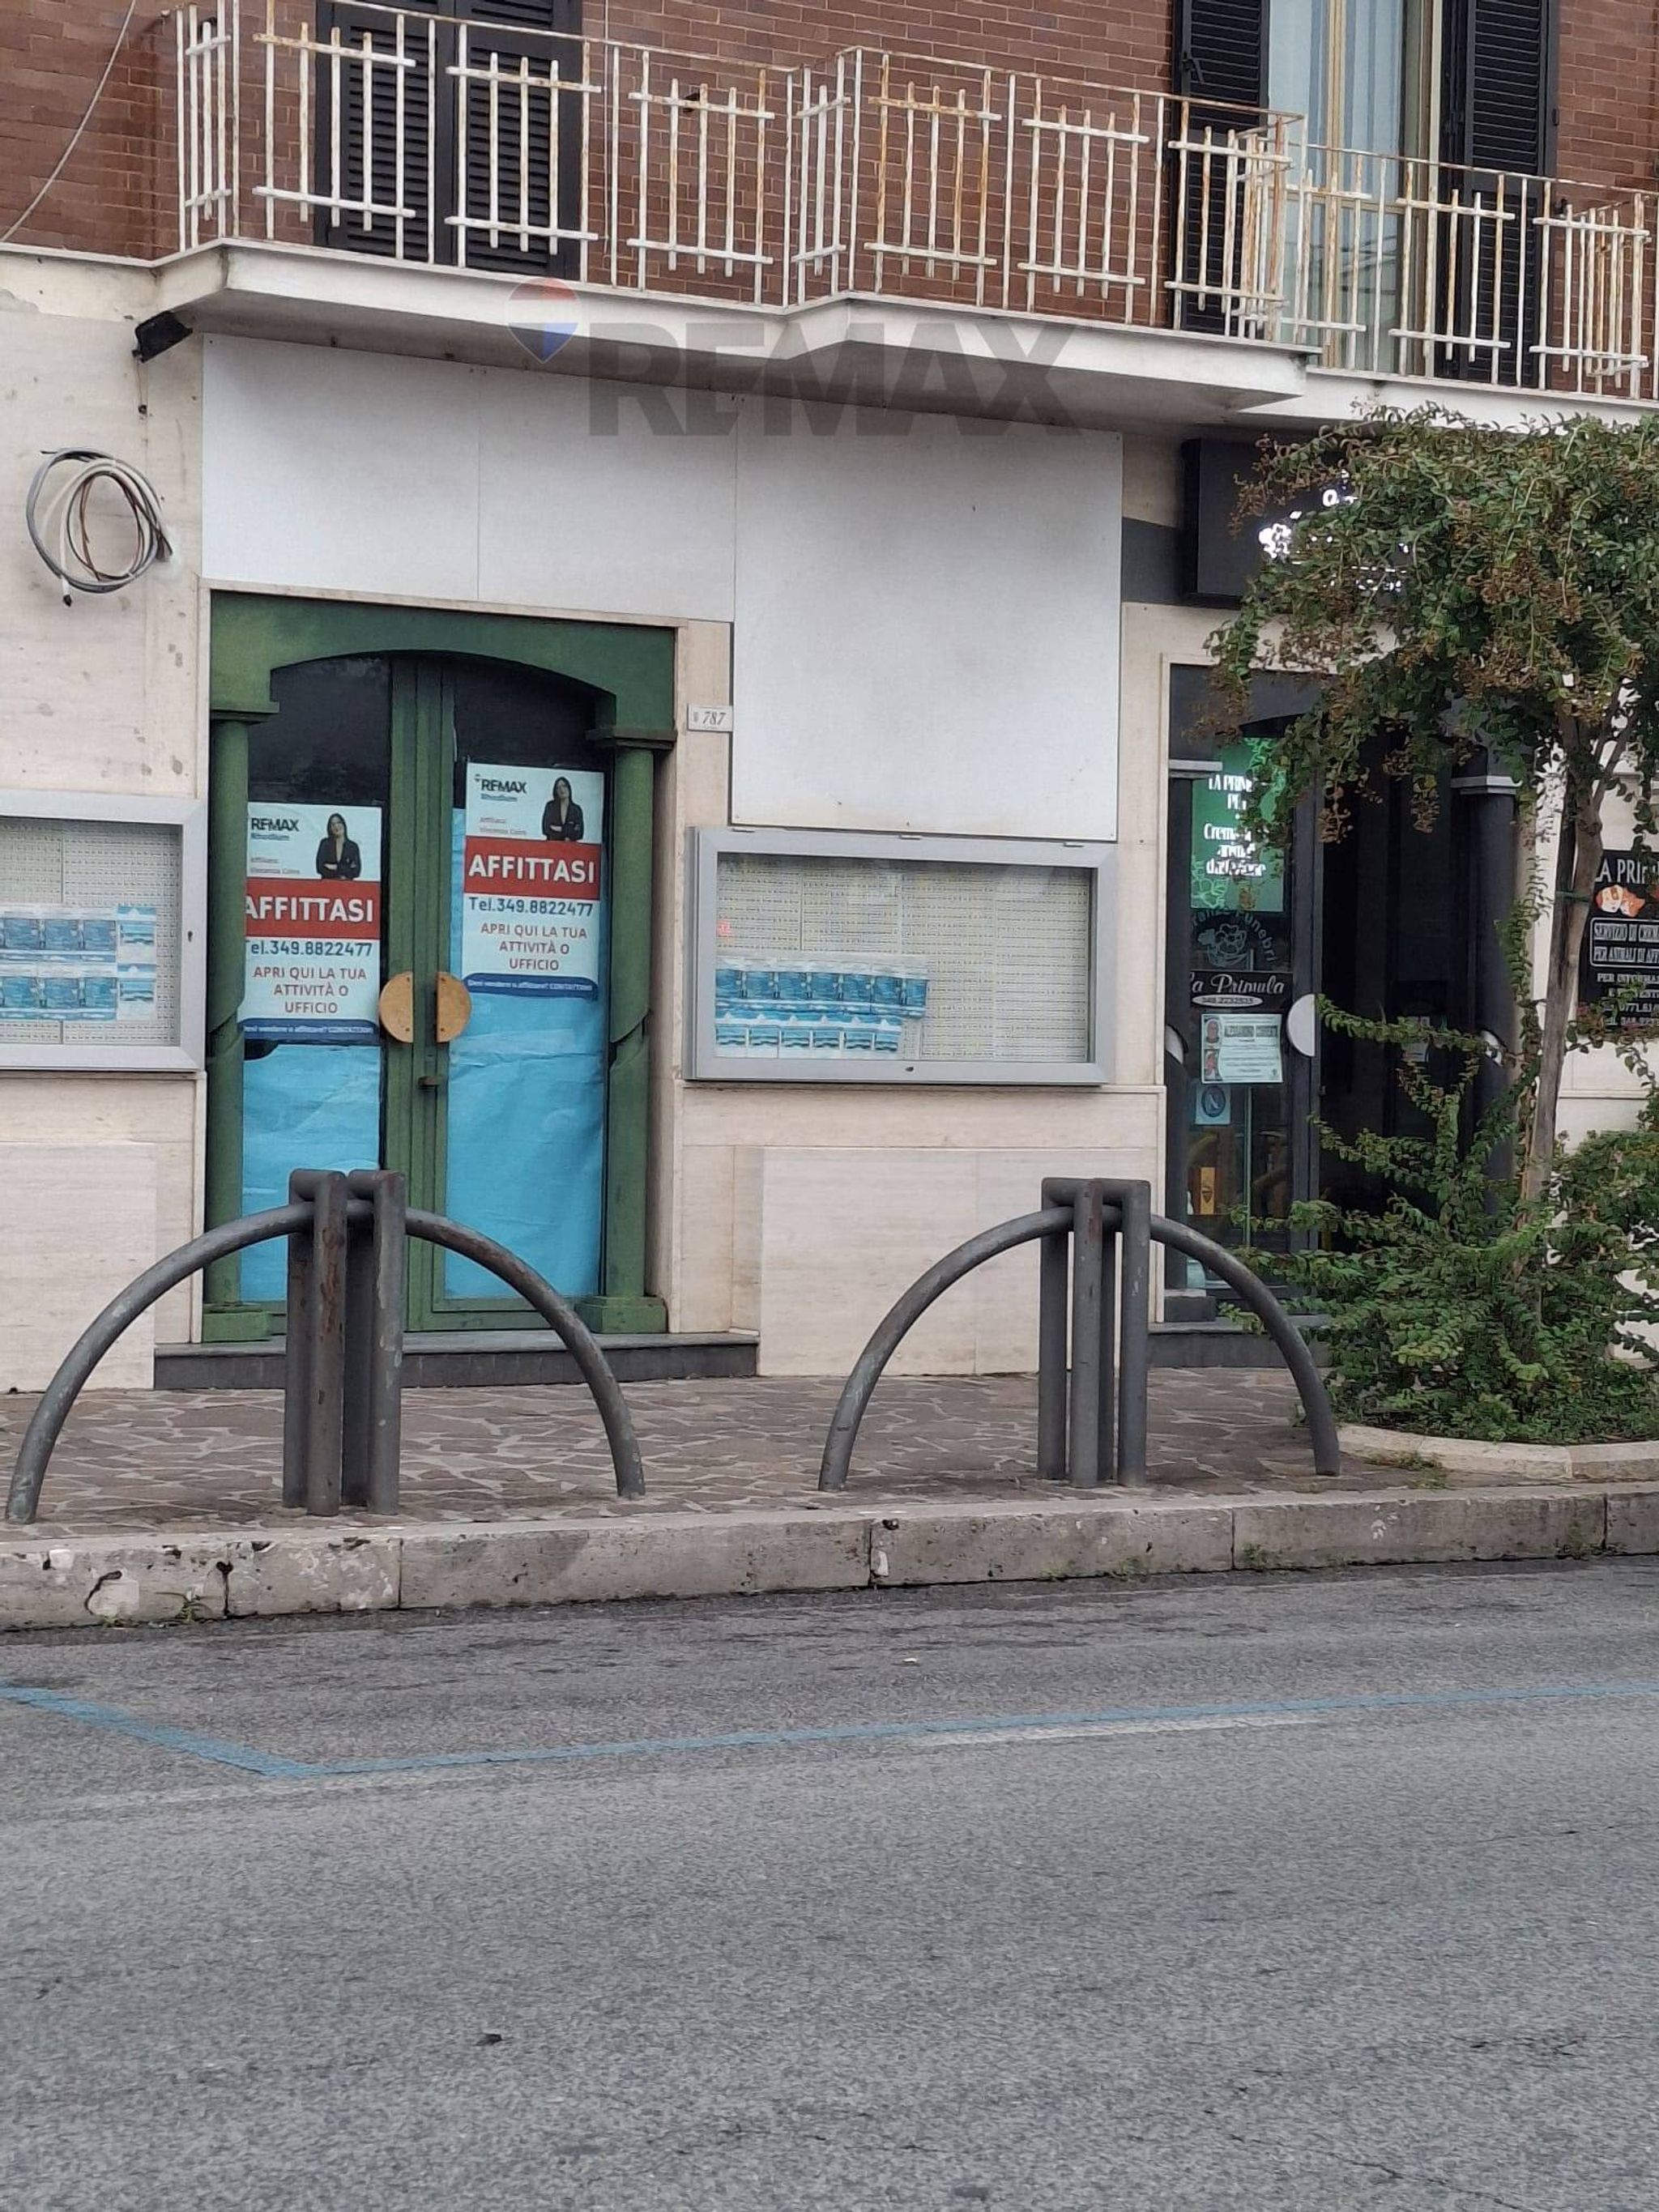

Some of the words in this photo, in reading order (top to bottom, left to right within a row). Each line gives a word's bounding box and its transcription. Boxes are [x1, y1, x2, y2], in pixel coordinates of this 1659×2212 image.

[702, 711, 727, 725] 787
[480, 779, 527, 794] REMAX
[250, 817, 300, 832] REMAX
[468, 855, 595, 884] AFFITTASI
[1595, 859, 1611, 883] A
[245, 895, 373, 923] AFFITTASI
[469, 897, 593, 917] Tel.349.8822477
[480, 923, 510, 935] APRI
[514, 925, 538, 937] QUI
[542, 927, 558, 938] LA
[561, 927, 587, 939] TUA
[499, 940, 557, 954] ATTIVITÀ
[560, 944, 569, 955] O
[509, 958, 559, 971] UFFICIO
[253, 966, 284, 978] APRI
[289, 966, 313, 979] QUI
[318, 968, 335, 979] LA
[339, 968, 367, 980] TUA
[273, 982, 334, 997] ATTIVITÀ
[339, 985, 349, 997] O
[1210, 974, 1285, 995] Primula
[284, 1002, 338, 1014] UFFICIO
